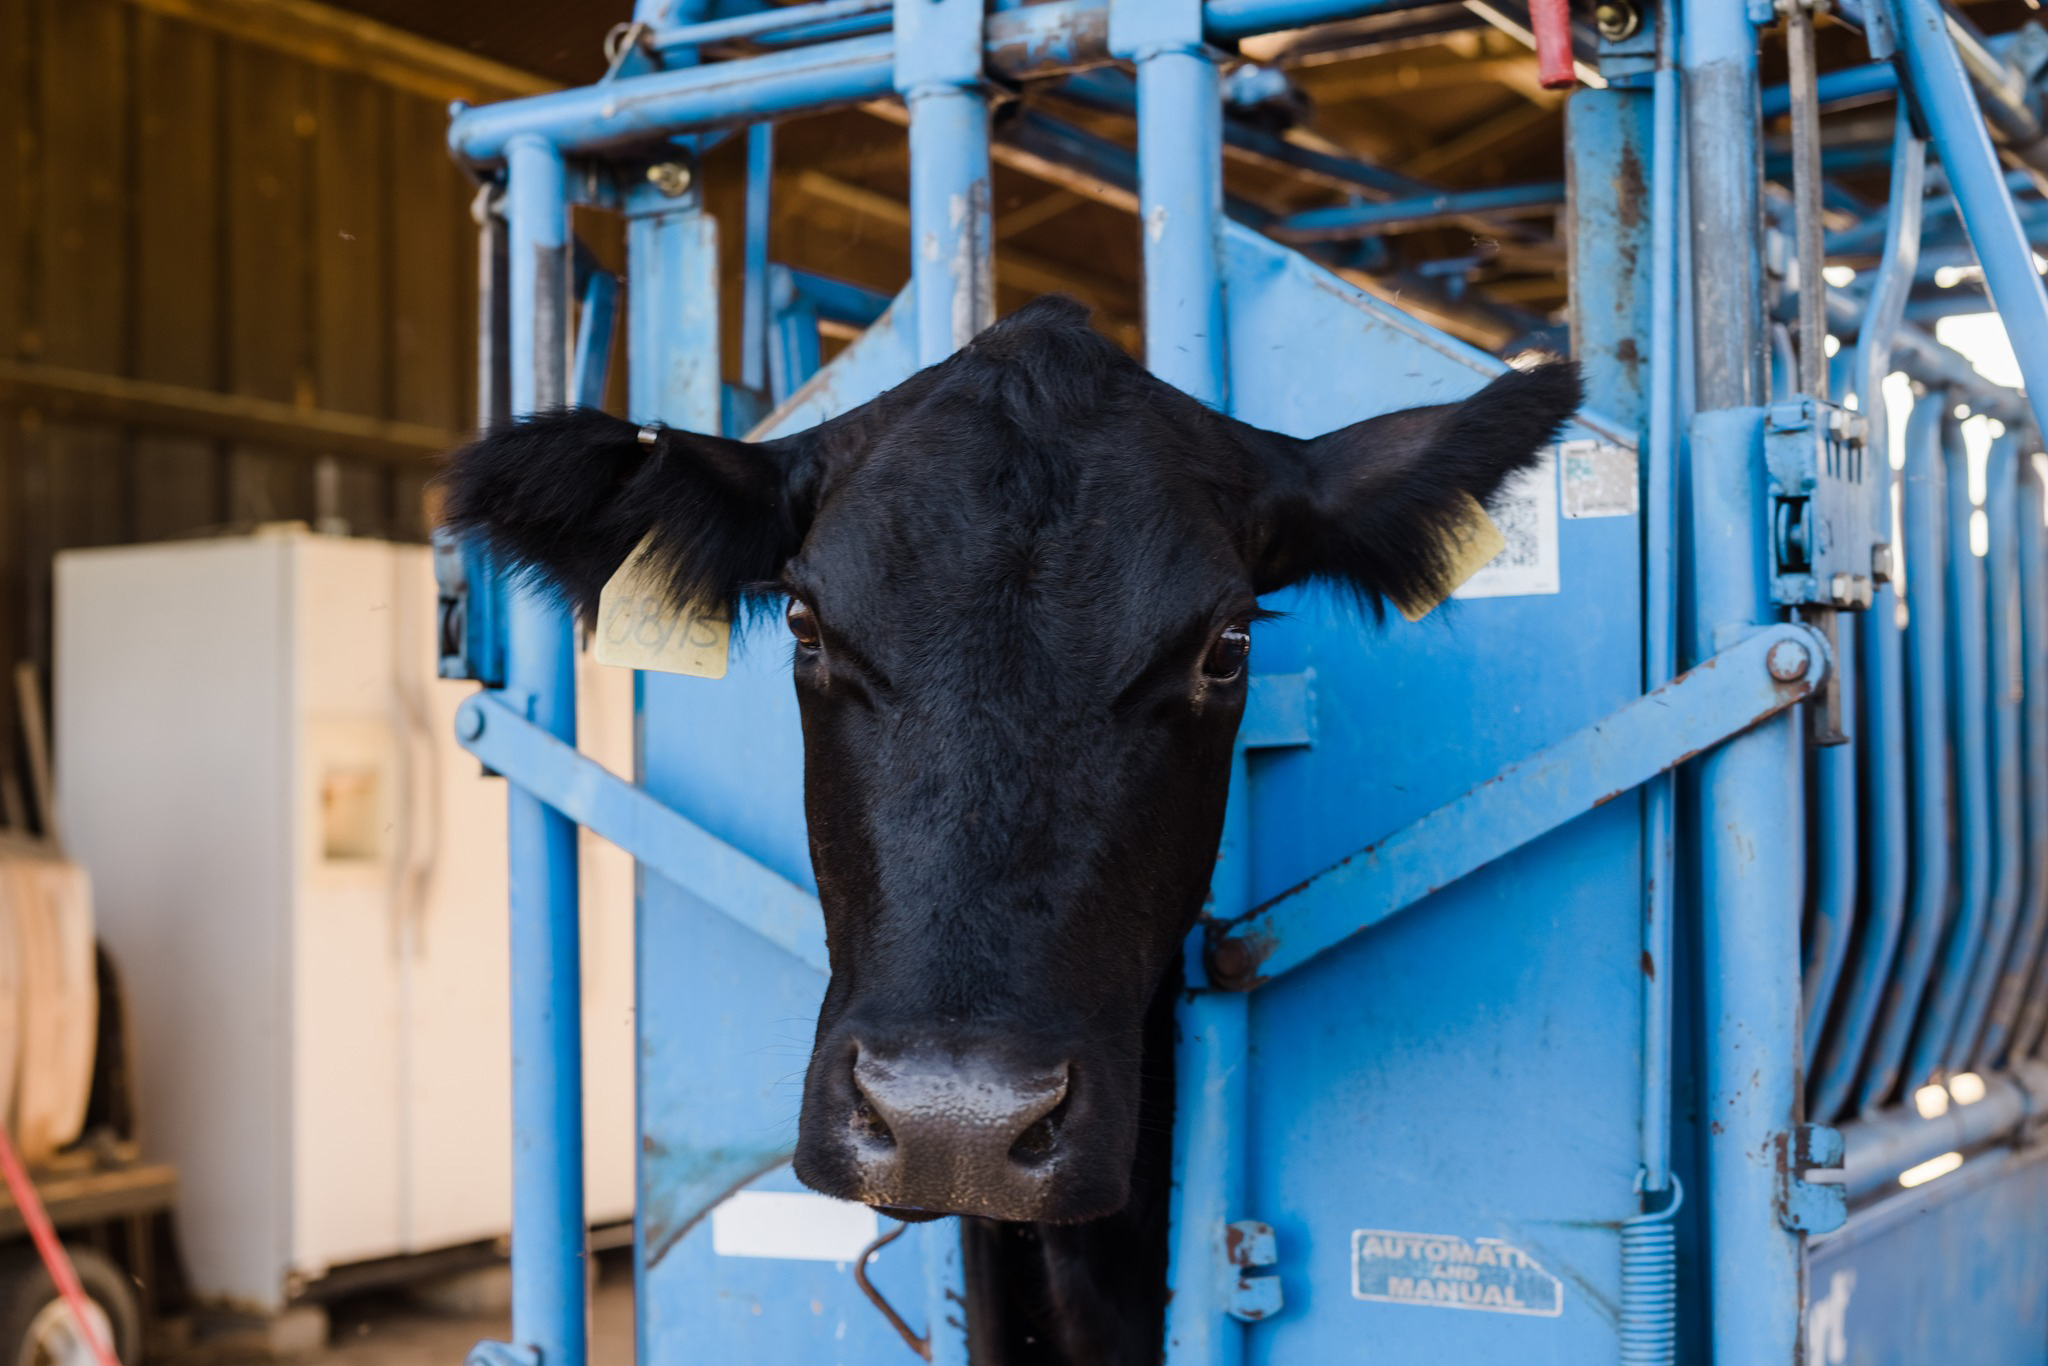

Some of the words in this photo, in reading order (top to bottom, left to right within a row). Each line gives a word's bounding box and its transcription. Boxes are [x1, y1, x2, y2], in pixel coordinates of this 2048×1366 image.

[1361, 1236, 1529, 1269] AUTOMATI
[1431, 1264, 1479, 1281] AND
[1388, 1277, 1525, 1307] MANUAL
